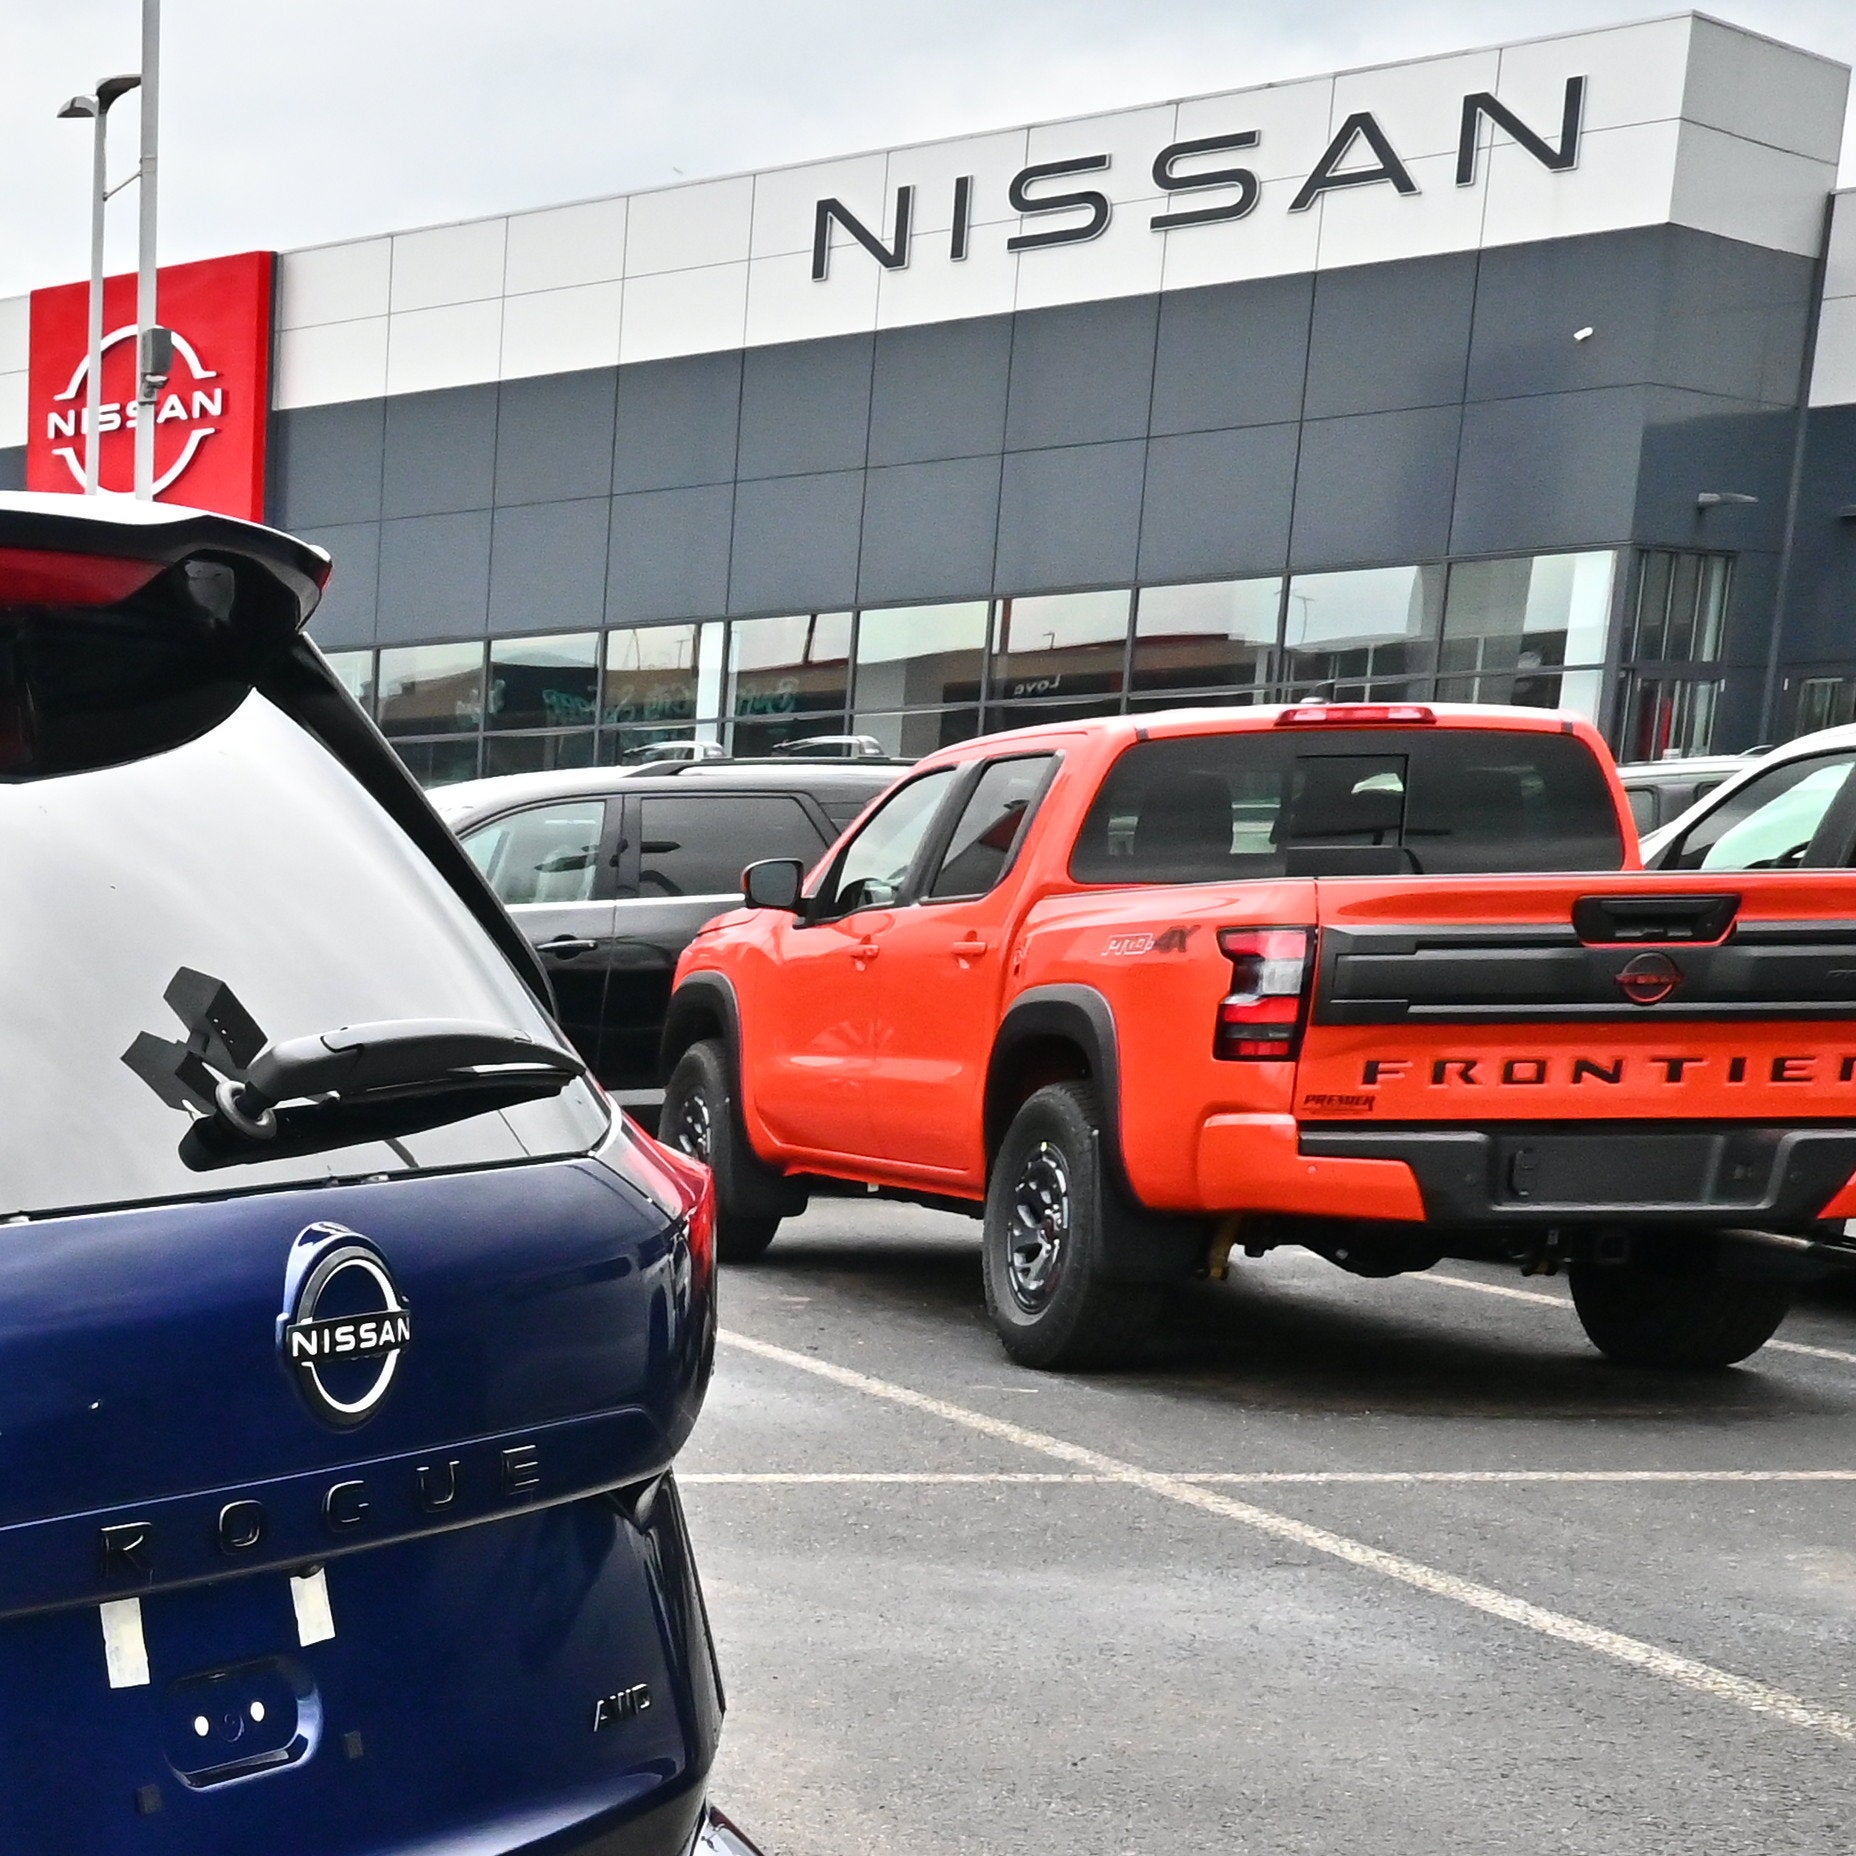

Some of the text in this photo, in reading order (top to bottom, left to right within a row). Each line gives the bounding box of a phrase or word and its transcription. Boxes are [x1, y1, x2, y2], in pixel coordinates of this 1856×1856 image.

[810, 74, 1590, 283] NISSAN
[291, 1317, 410, 1357] NISSAN
[101, 1445, 540, 1578] ROGUE
[593, 1683, 650, 1732] AWD
